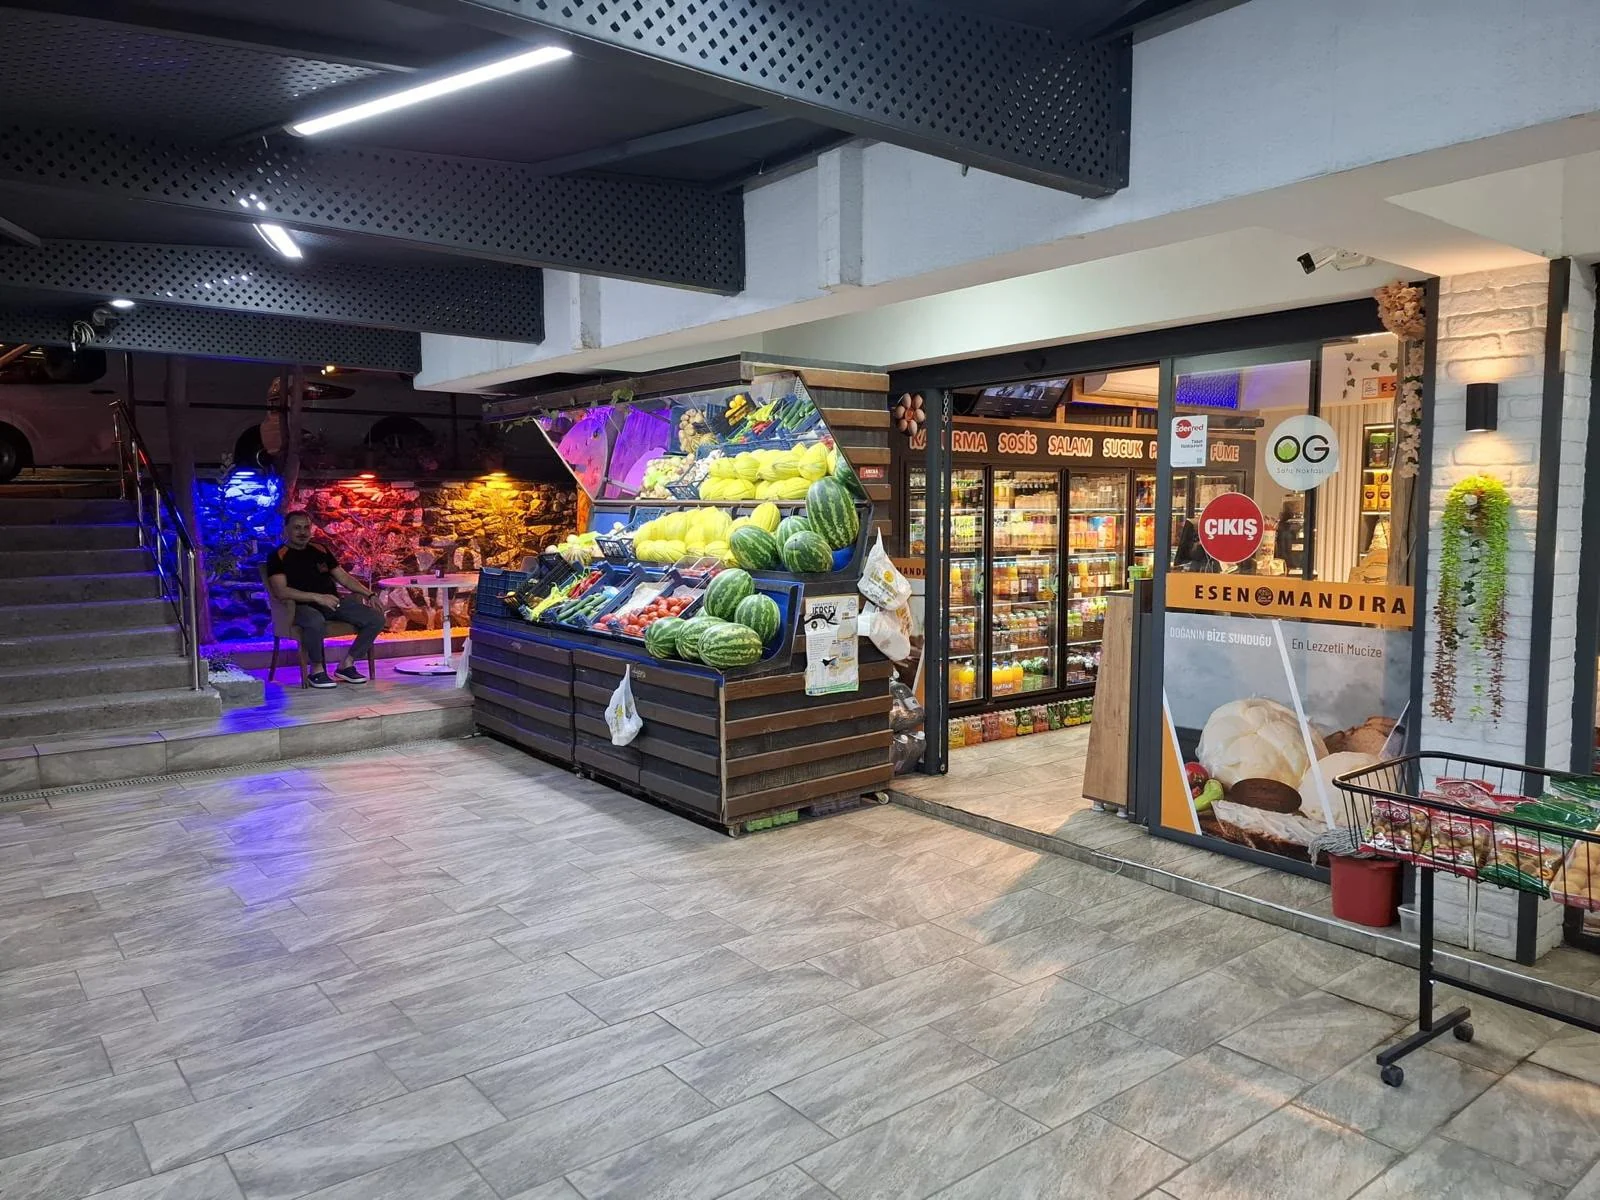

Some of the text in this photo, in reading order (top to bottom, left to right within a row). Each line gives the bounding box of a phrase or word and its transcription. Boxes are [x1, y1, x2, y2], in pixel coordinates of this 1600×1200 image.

[998, 430, 1037, 454] SOSİS
[1047, 435, 1093, 457] SALAM
[1103, 438, 1143, 459] SUCUK
[1210, 440, 1240, 462] FÜME
[1273, 434, 1330, 463] OG
[1204, 518, 1258, 541] ÇIKIŞ
[1194, 584, 1251, 602] ESEN
[1277, 590, 1407, 615] MANDIRA
[1170, 626, 1272, 647] DOĞANIN BİZE SUNDUĞU
[1292, 638, 1383, 658] En Lezzetli Mucize
